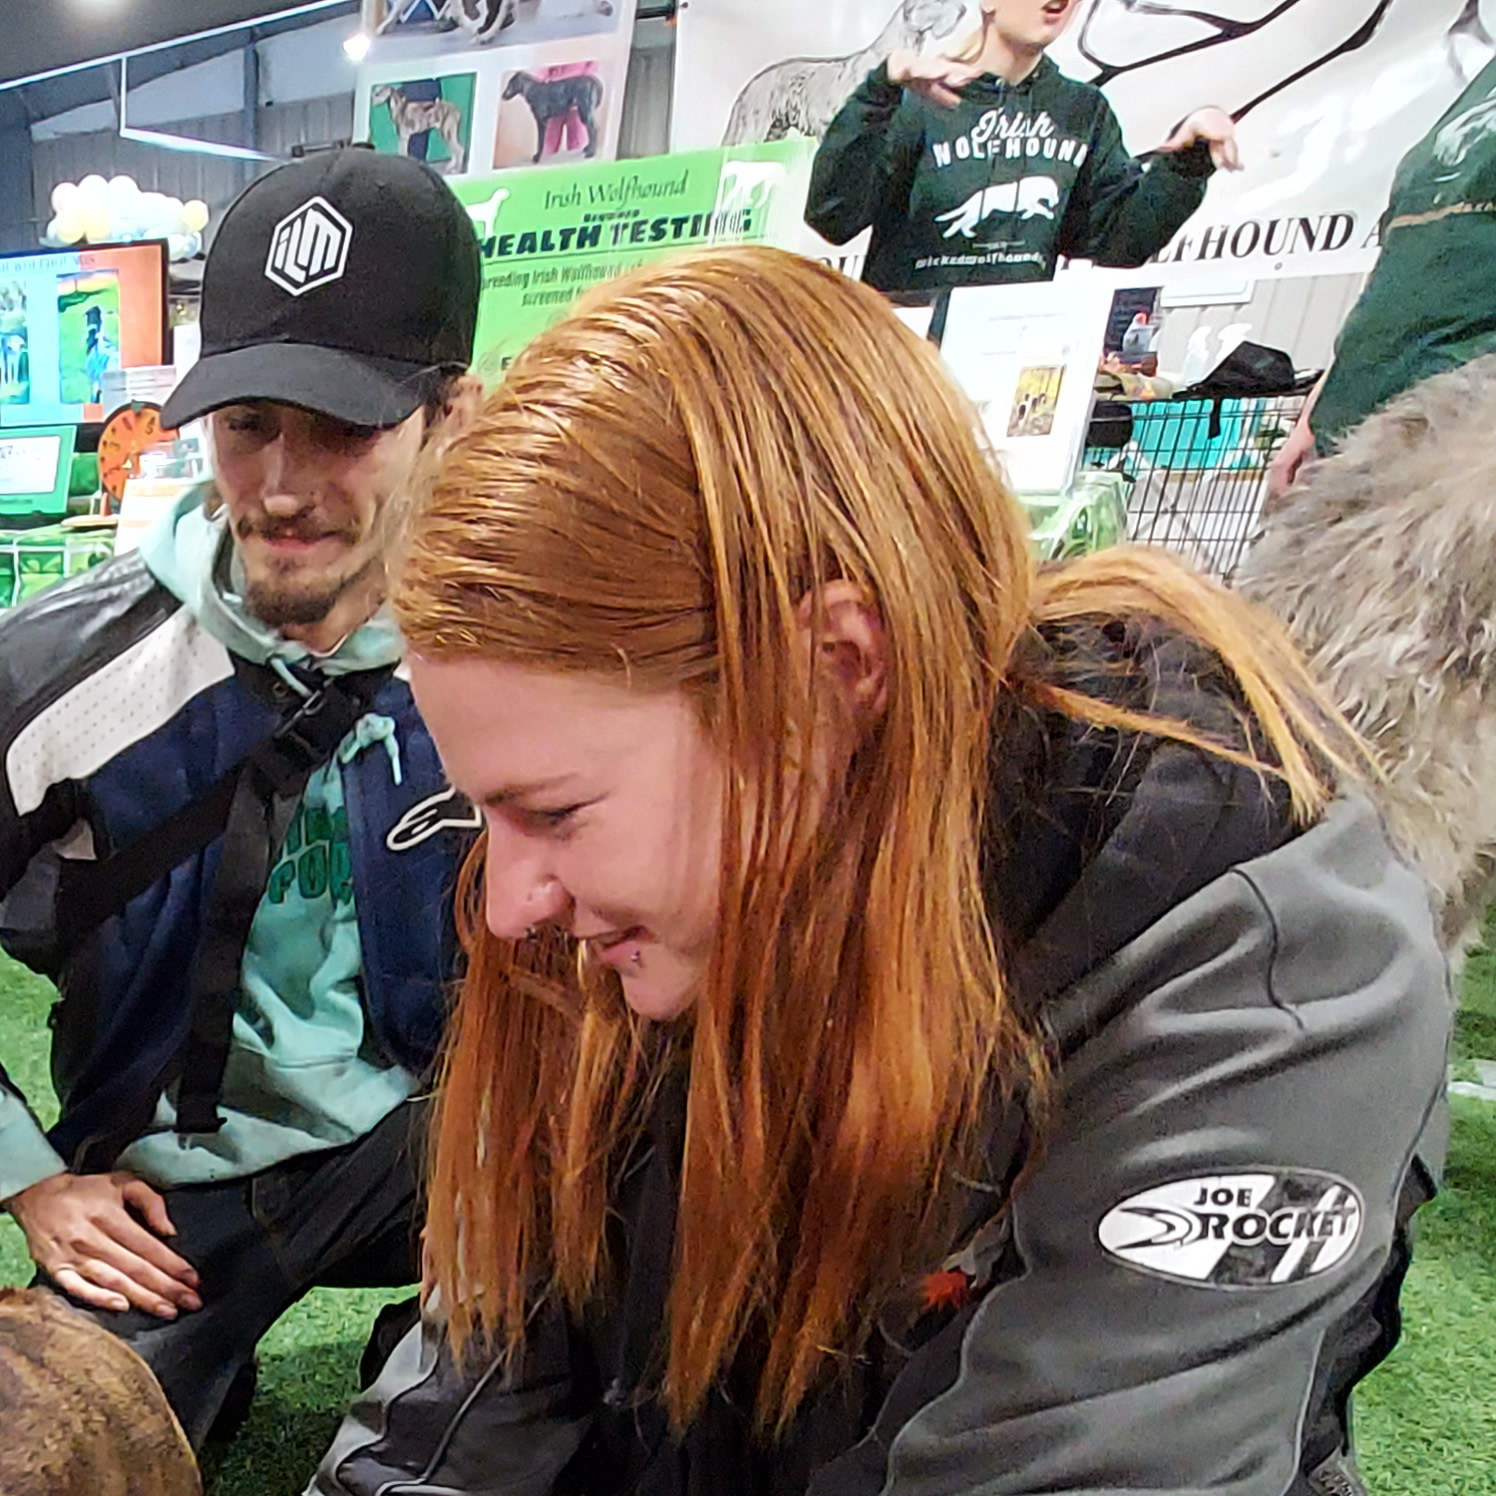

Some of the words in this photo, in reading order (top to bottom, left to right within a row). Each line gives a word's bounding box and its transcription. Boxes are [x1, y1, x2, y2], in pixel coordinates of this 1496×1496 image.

[970, 107, 1055, 143] Irish
[544, 182, 581, 210] Irish
[589, 169, 689, 210] Wolfhound
[478, 224, 602, 259] HEALTH
[609, 208, 752, 247] TESTING
[1193, 1186, 1253, 1207] JOE
[1194, 1206, 1358, 1242] ROCKET
